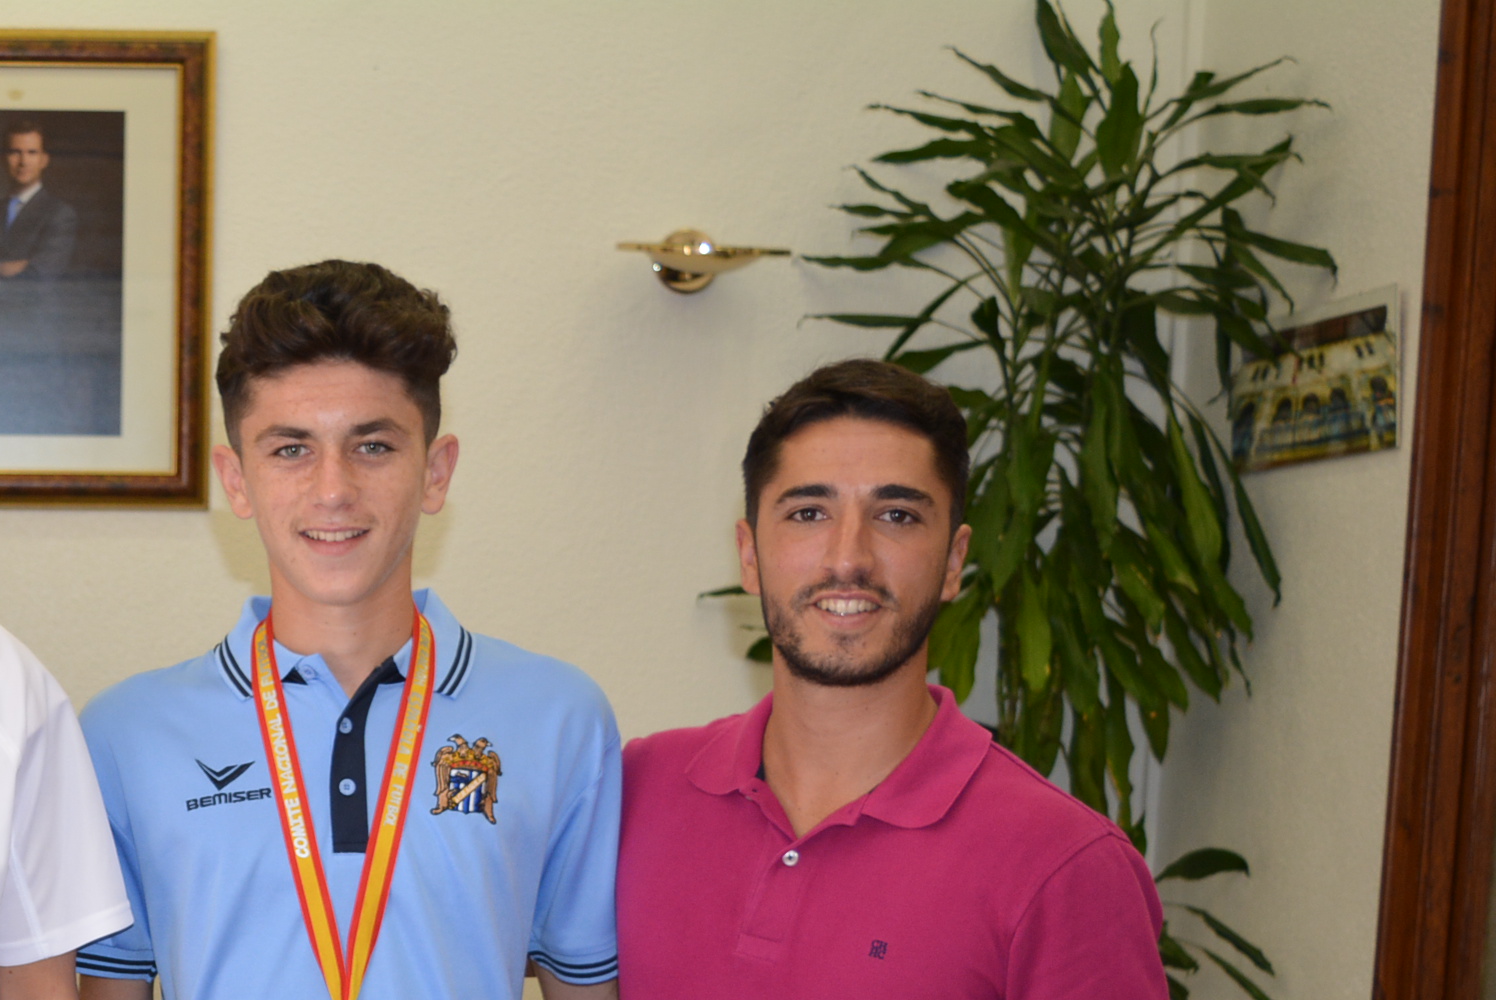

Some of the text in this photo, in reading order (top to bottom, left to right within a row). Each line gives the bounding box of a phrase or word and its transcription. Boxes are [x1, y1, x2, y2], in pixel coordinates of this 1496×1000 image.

[257, 637, 274, 688] FUTBOL
[262, 689, 279, 711] DE
[269, 713, 297, 794] NACIONAL
[394, 761, 408, 779] DE
[186, 787, 272, 812] BEMISER
[383, 783, 404, 826] FUTBOL
[284, 797, 311, 859] COMITE
